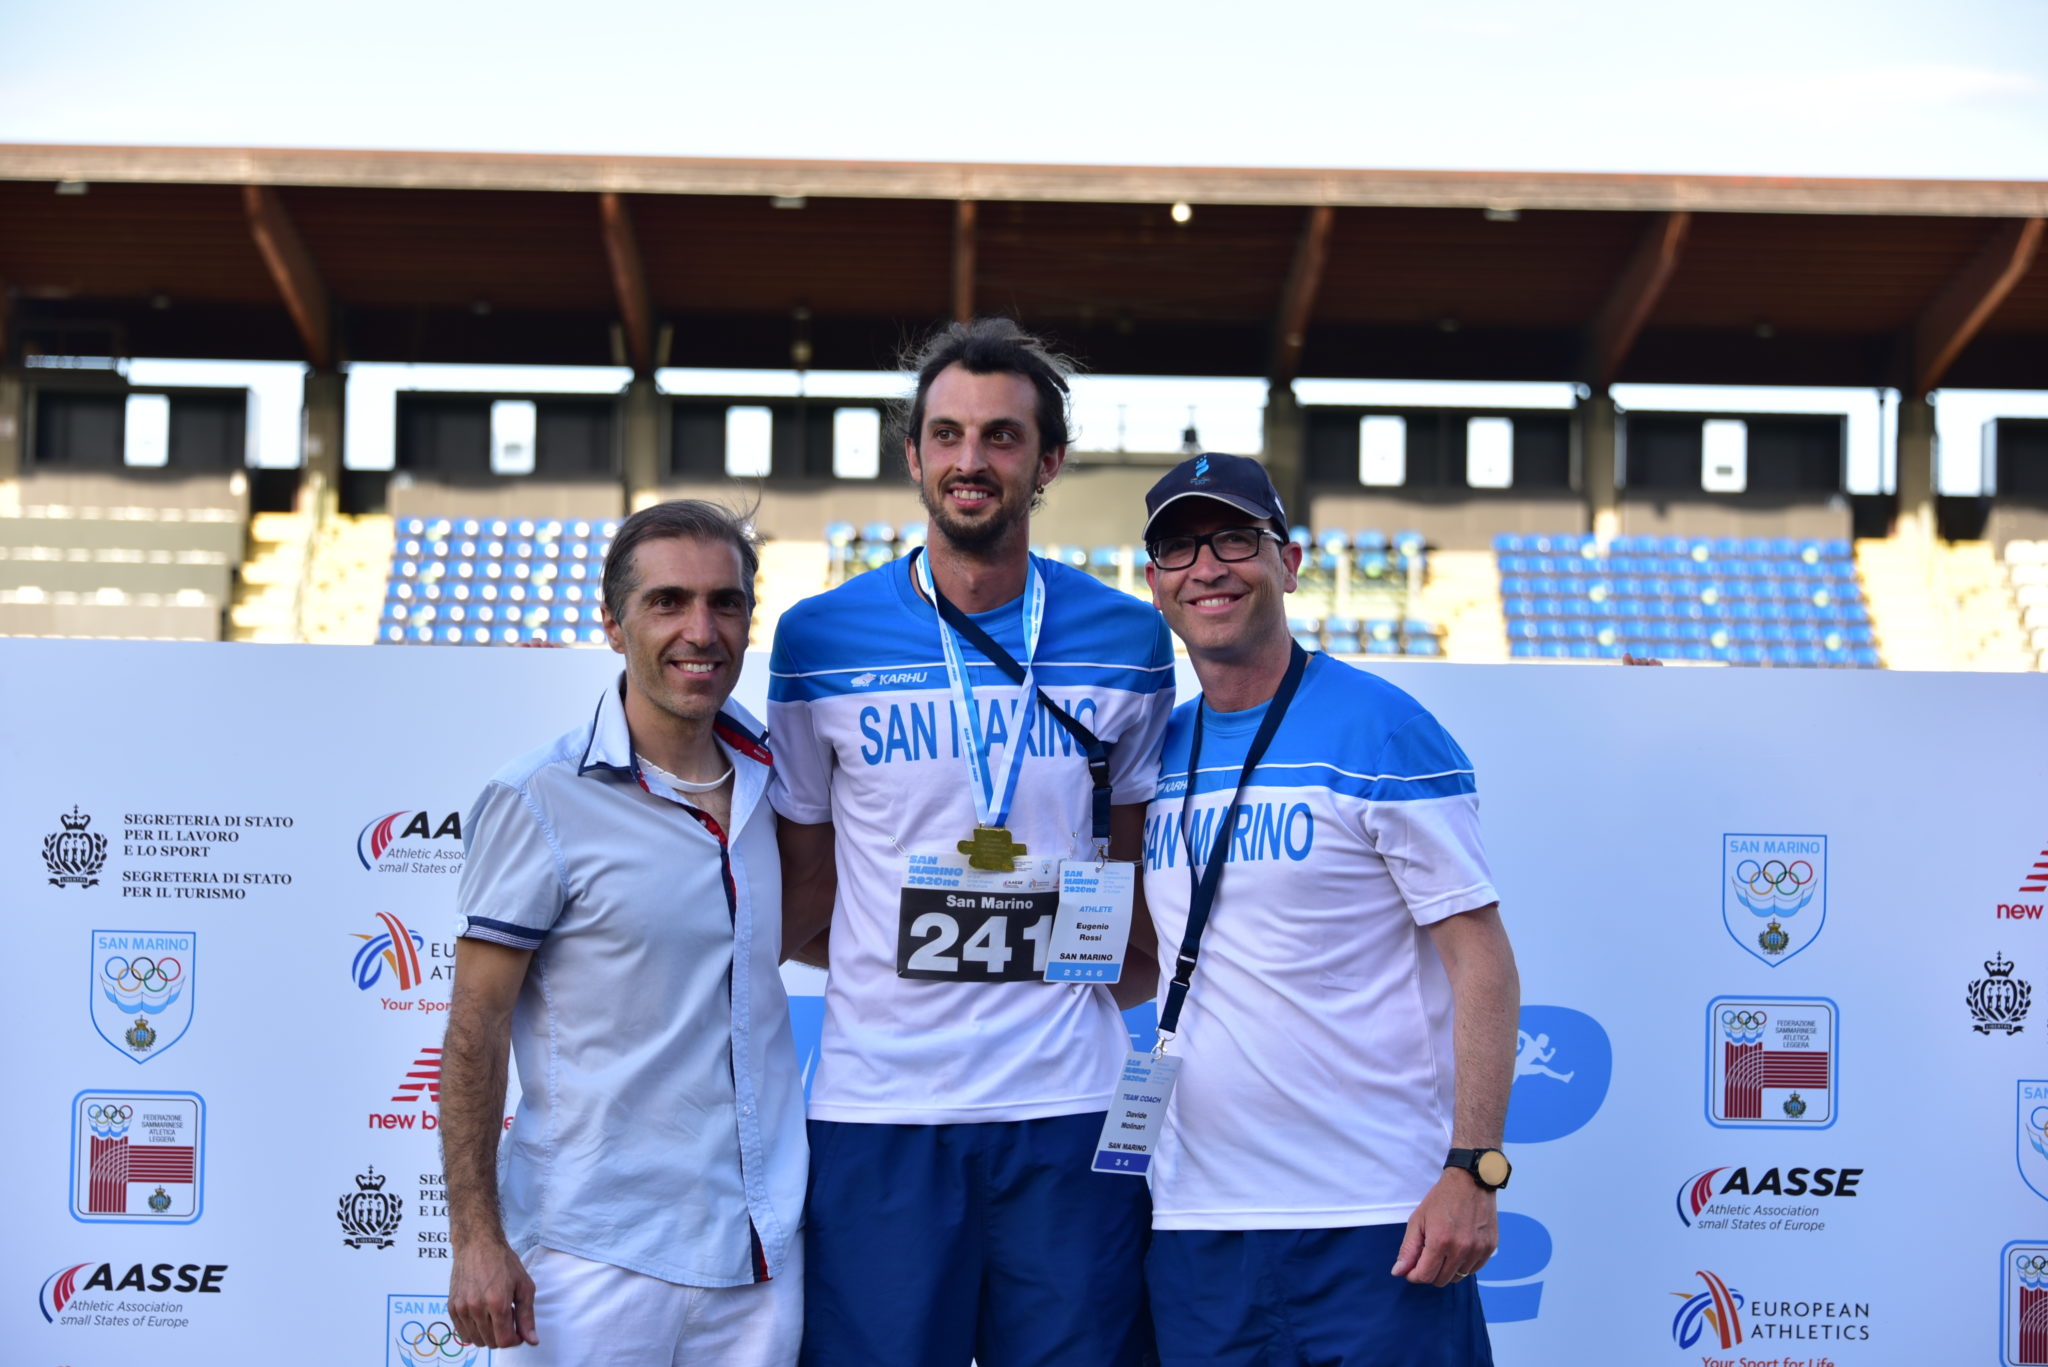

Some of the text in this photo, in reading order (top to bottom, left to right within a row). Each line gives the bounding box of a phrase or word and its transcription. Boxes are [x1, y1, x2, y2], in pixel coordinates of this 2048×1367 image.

[879, 672, 928, 685] KARHU
[859, 701, 938, 766] SAN
[1164, 780, 1188, 793] KARH
[124, 814, 294, 828] SEGRETERIA DI STATO
[400, 811, 463, 839] AA
[124, 829, 239, 842] PER IL LAVORO
[124, 845, 210, 857] E LO SPORT
[386, 848, 466, 860] Athletic Assoc
[1730, 840, 1820, 855] SAN MARINO
[909, 855, 938, 865] SAN
[378, 862, 463, 874] small States of
[908, 865, 963, 877] MARINO
[122, 871, 292, 885] SEGRETERIA DI STATO
[122, 886, 246, 900] PER IL TURISMO
[946, 895, 1034, 910] San Marino
[1996, 904, 2044, 920] new
[1076, 922, 1109, 931] Eugenio
[98, 937, 189, 952] SAN MARINO
[907, 912, 1053, 973] 241
[432, 943, 456, 958] EU
[1080, 953, 1113, 961] MARINO
[430, 965, 455, 980] AT
[1074, 969, 1082, 977] 3
[381, 998, 452, 1015] Your Spor
[1777, 1020, 1816, 1028] FEDERAZIONE
[1775, 1027, 1818, 1035] SAMMARINESE
[1783, 1034, 1810, 1042] ATLETICA
[1783, 1041, 1810, 1049] LEGGERA
[1122, 1093, 1162, 1104] TEAM COACH
[143, 1114, 182, 1122] FEDERAZIONE
[1126, 1110, 1148, 1119] Davide
[141, 1121, 184, 1129] SAMMARINESE
[369, 1113, 415, 1130] new
[1121, 1122, 1146, 1131] Molinari
[149, 1128, 176, 1136] ATLETICA
[1122, 1143, 1147, 1152] MARINO
[1123, 1159, 1129, 1167] 4
[1719, 1166, 1864, 1197] AASSE
[420, 1190, 448, 1201] PER
[419, 1206, 429, 1216] E
[1706, 1204, 1819, 1217] Athletic Association
[1698, 1218, 1825, 1233] small States of Europe
[418, 1247, 448, 1258] PER
[83, 1263, 229, 1293] AASSE
[69, 1300, 183, 1313] Athletic Association
[394, 1302, 450, 1315] SAN MA
[1752, 1301, 1869, 1319] EUROPEAN
[60, 1314, 189, 1329] small States of Europe
[1751, 1324, 1869, 1341] ATHLETICS
[1702, 1357, 1734, 1367] Your
[1782, 1358, 1805, 1367] for
